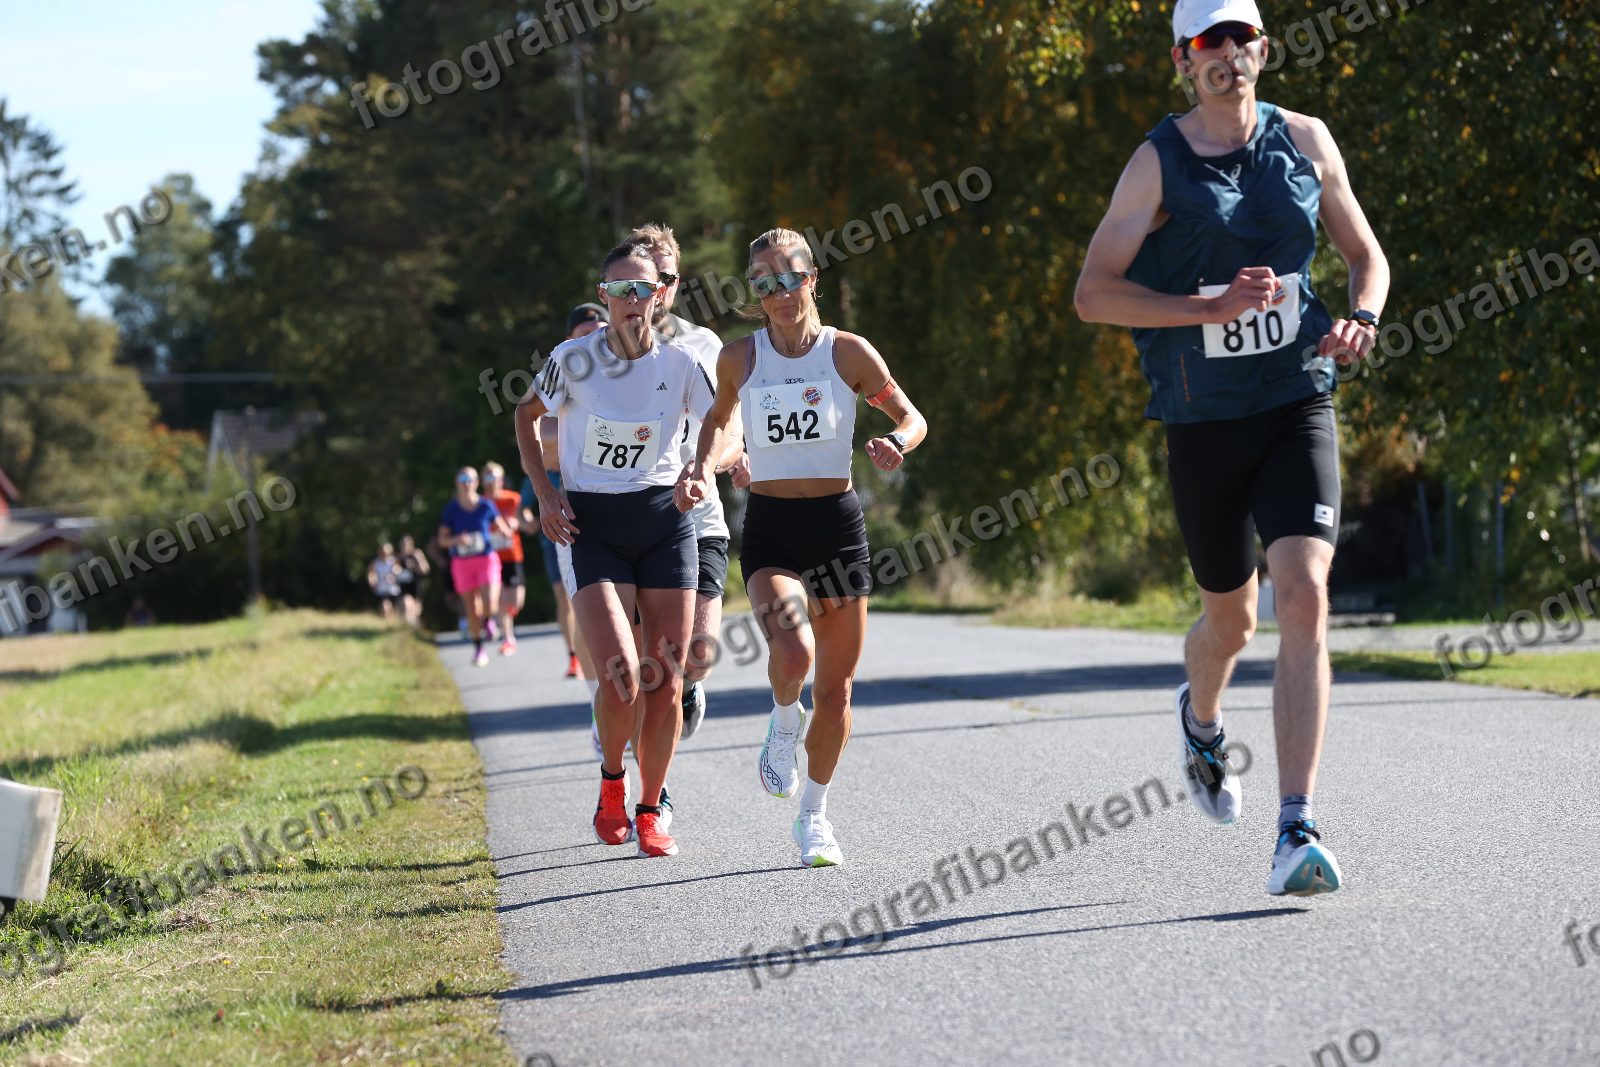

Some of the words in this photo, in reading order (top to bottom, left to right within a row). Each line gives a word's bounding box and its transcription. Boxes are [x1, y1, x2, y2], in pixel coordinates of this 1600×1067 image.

[1223, 310, 1284, 353] 810
[767, 409, 821, 444] 542
[597, 441, 645, 469] 787
